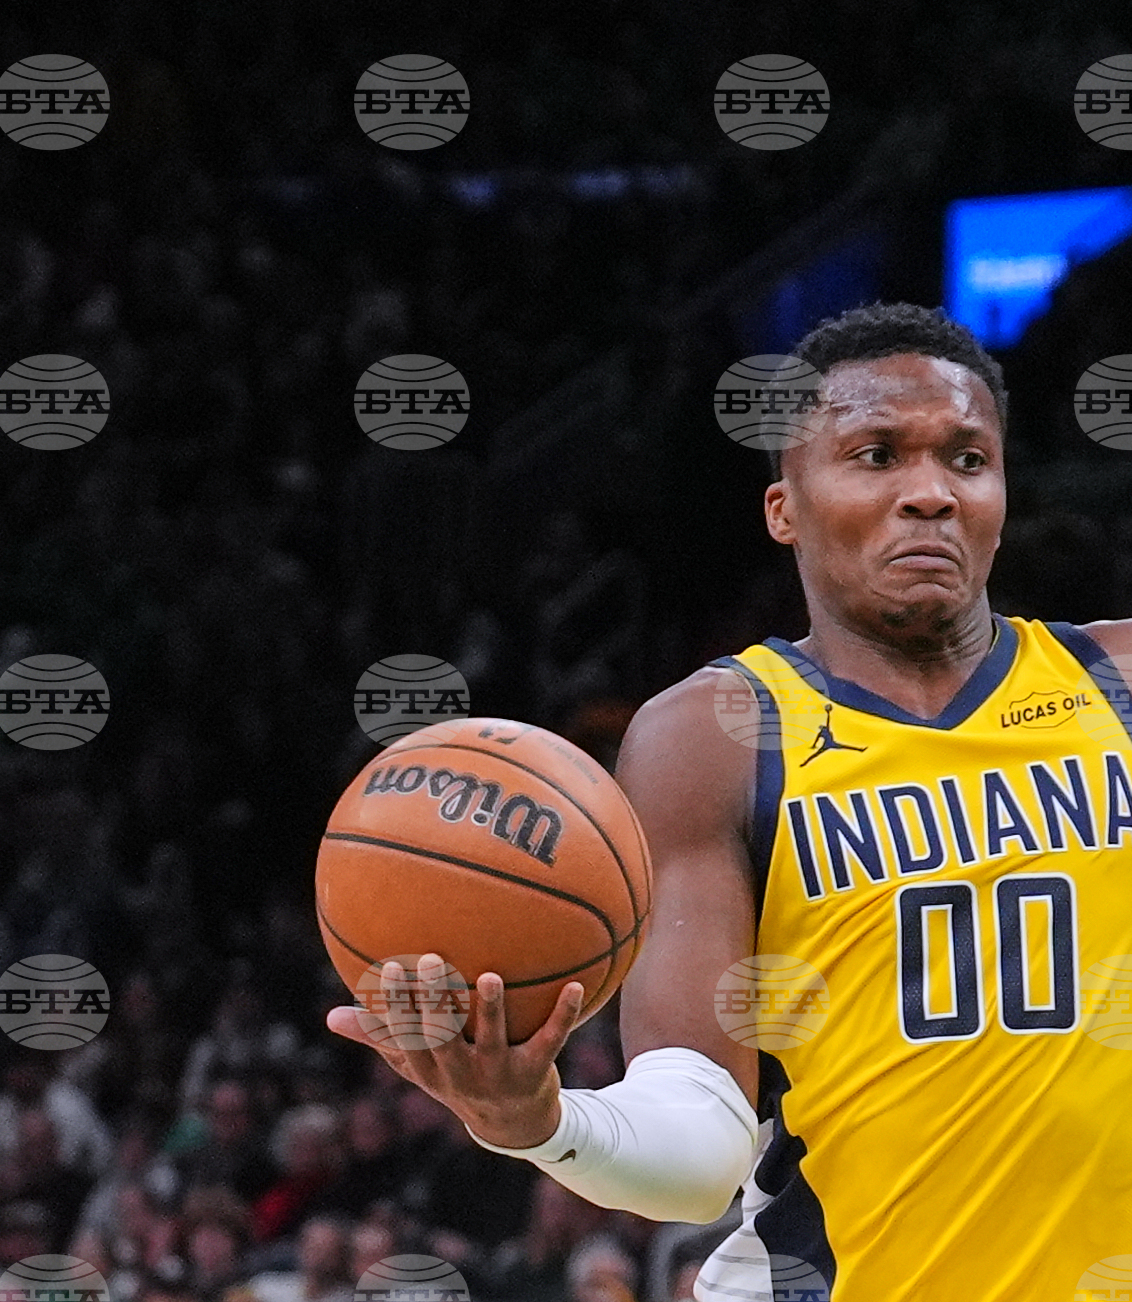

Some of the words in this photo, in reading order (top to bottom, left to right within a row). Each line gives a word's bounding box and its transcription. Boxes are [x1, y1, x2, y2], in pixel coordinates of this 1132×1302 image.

[1001, 701, 1057, 728] LUCAS
[1063, 692, 1092, 711] OIL
[364, 765, 564, 868] Wilson
[896, 872, 1081, 1046] 00
